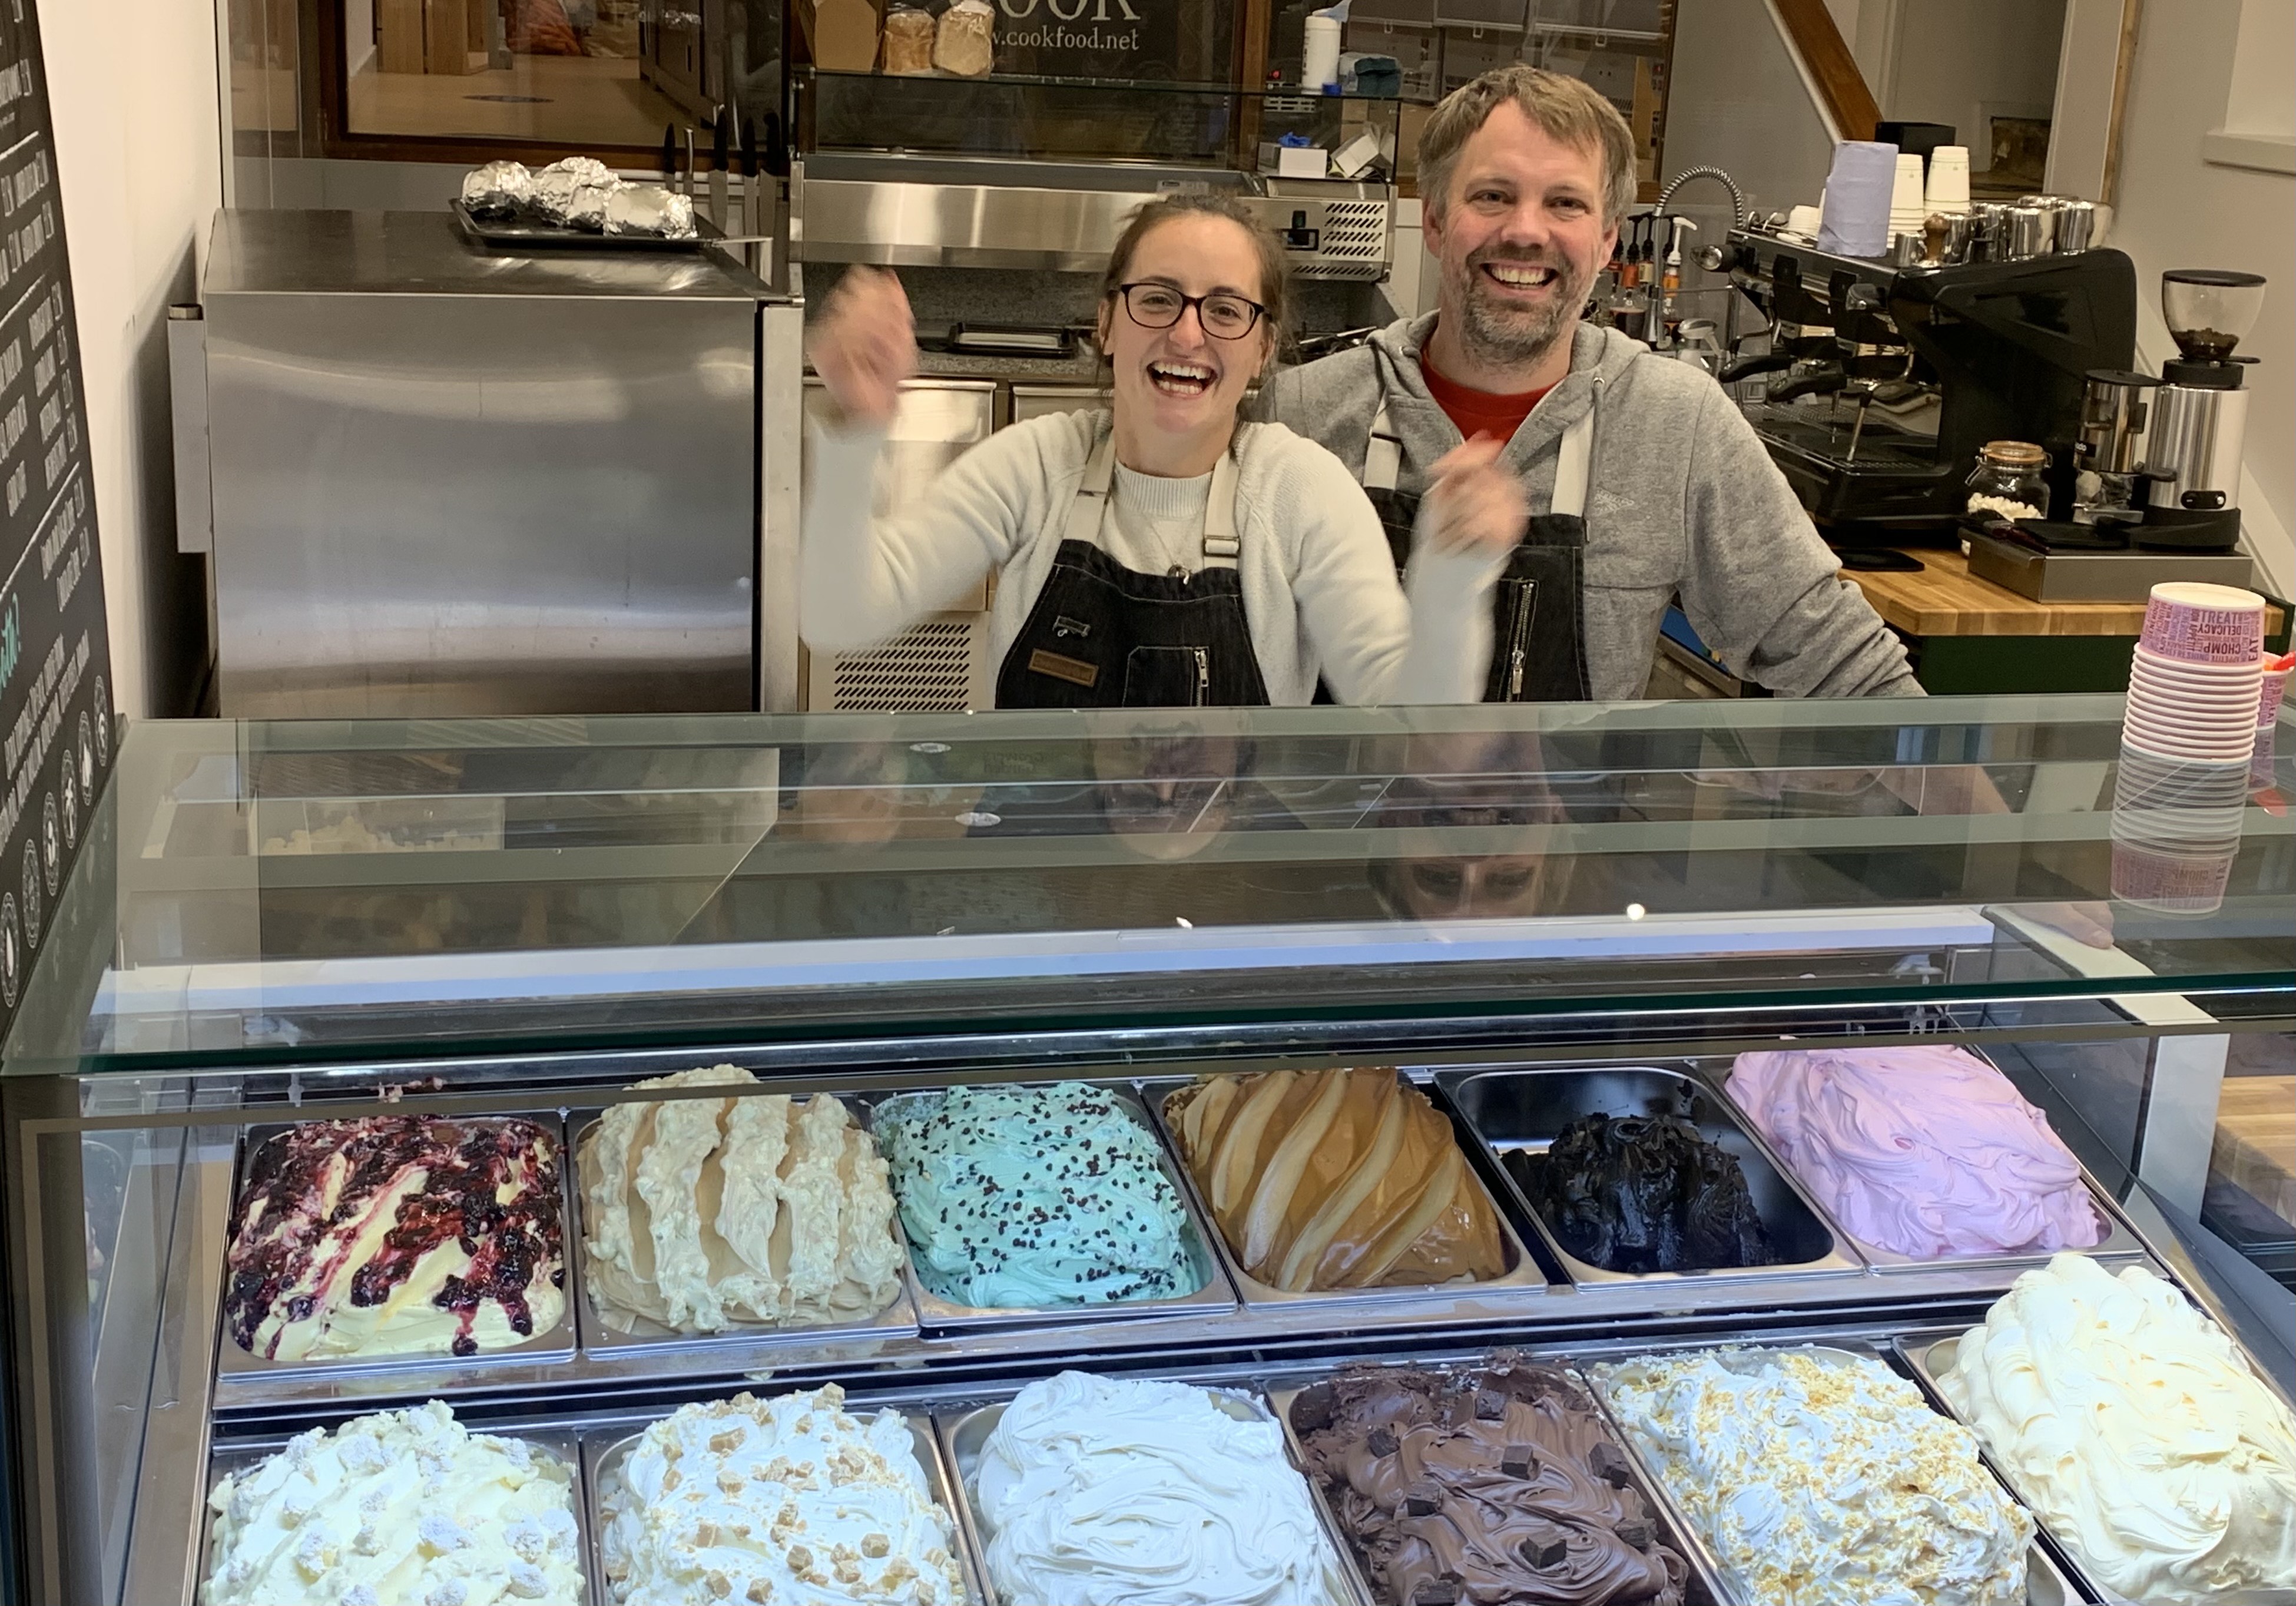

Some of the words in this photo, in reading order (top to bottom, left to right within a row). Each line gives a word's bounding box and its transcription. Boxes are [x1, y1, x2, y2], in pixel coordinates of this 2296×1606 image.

[2198, 623, 2242, 635] DELICACY
[2203, 642, 2242, 655] CHOMP
[2248, 638, 2259, 661] EAT
